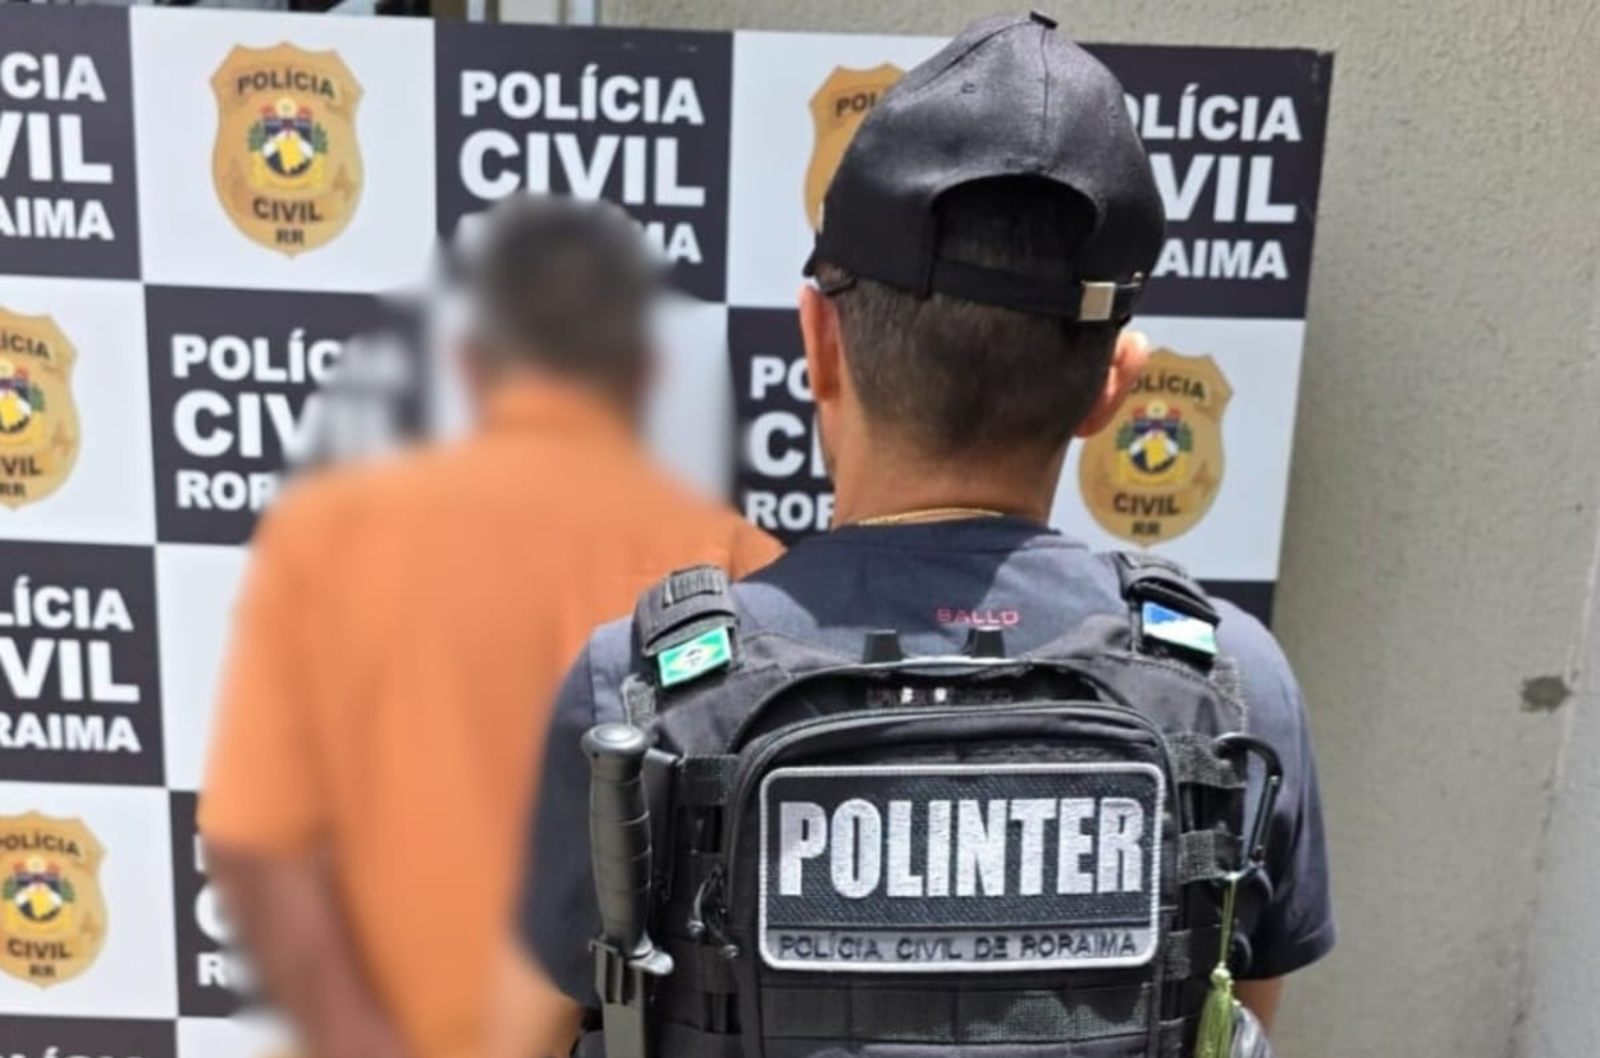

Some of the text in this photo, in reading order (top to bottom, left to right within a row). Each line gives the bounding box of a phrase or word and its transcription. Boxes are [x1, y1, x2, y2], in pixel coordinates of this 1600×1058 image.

[236, 66, 335, 99] POLÍCIA
[460, 64, 705, 125] POLÍCIA
[1123, 83, 1302, 142] LÍCIA
[459, 129, 706, 207] CIVIL
[1149, 153, 1297, 223] VIL
[252, 197, 323, 223] CIVIL
[275, 229, 304, 246] RR
[1150, 238, 1289, 280] AIMA
[170, 328, 345, 384] POLÍC
[1112, 492, 1181, 517] CIVIL
[778, 797, 1145, 899] POLINTER
[7, 938, 73, 961] CIVIL
[777, 932, 1136, 961] POLÍCIA CIVIL DE RORAIMA
